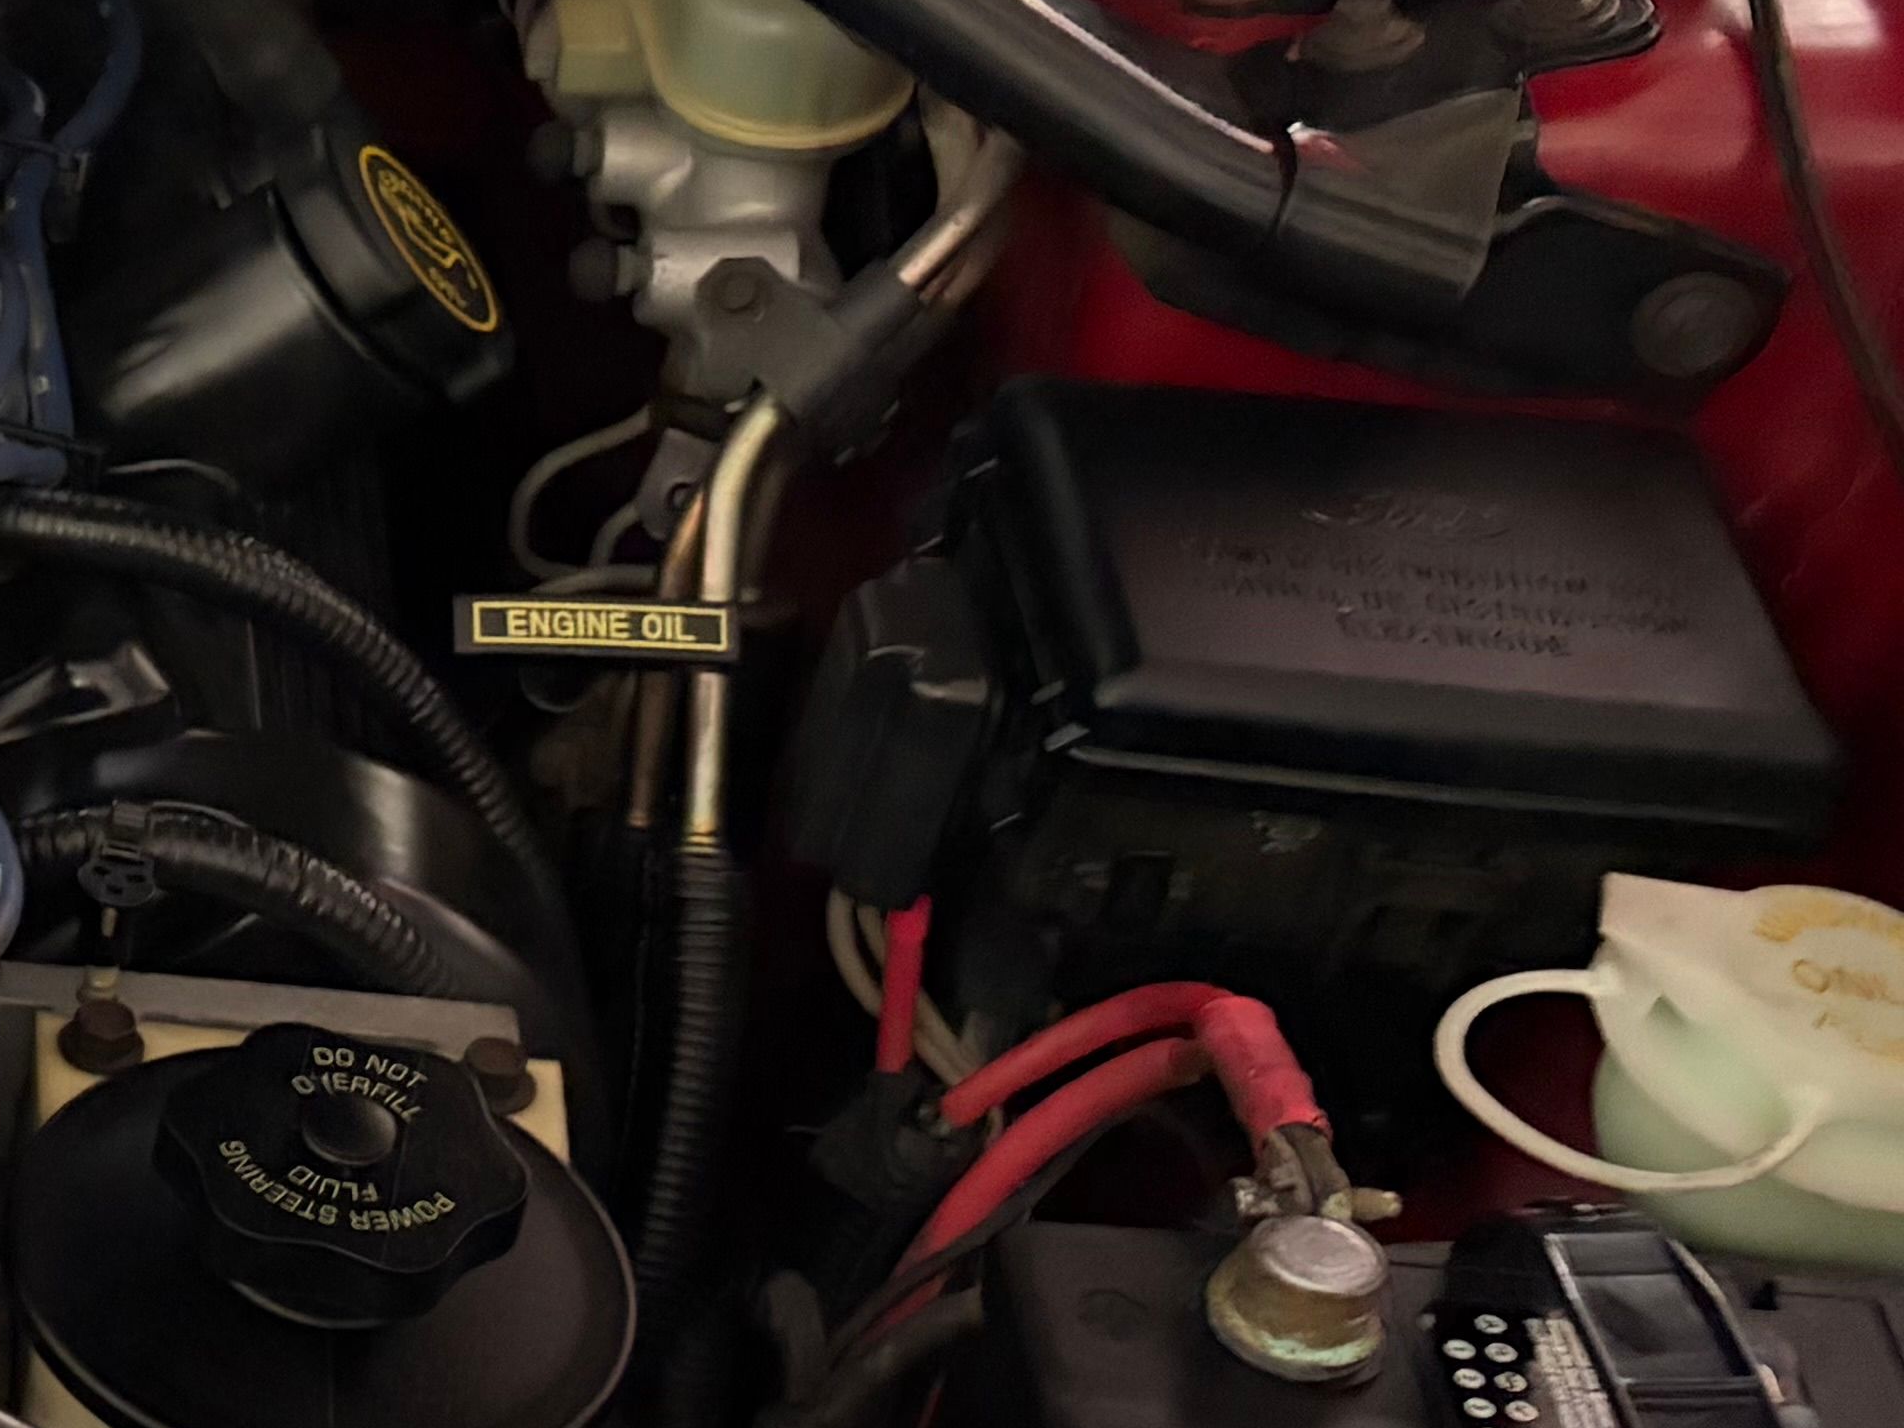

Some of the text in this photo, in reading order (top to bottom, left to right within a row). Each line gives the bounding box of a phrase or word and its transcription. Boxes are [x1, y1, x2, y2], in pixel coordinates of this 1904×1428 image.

[505, 608, 697, 643] ENGINE OIL
[313, 1046, 428, 1088] DO NOT
[218, 1140, 456, 1231] POWER STEERING
[287, 1164, 378, 1203] FLUID
